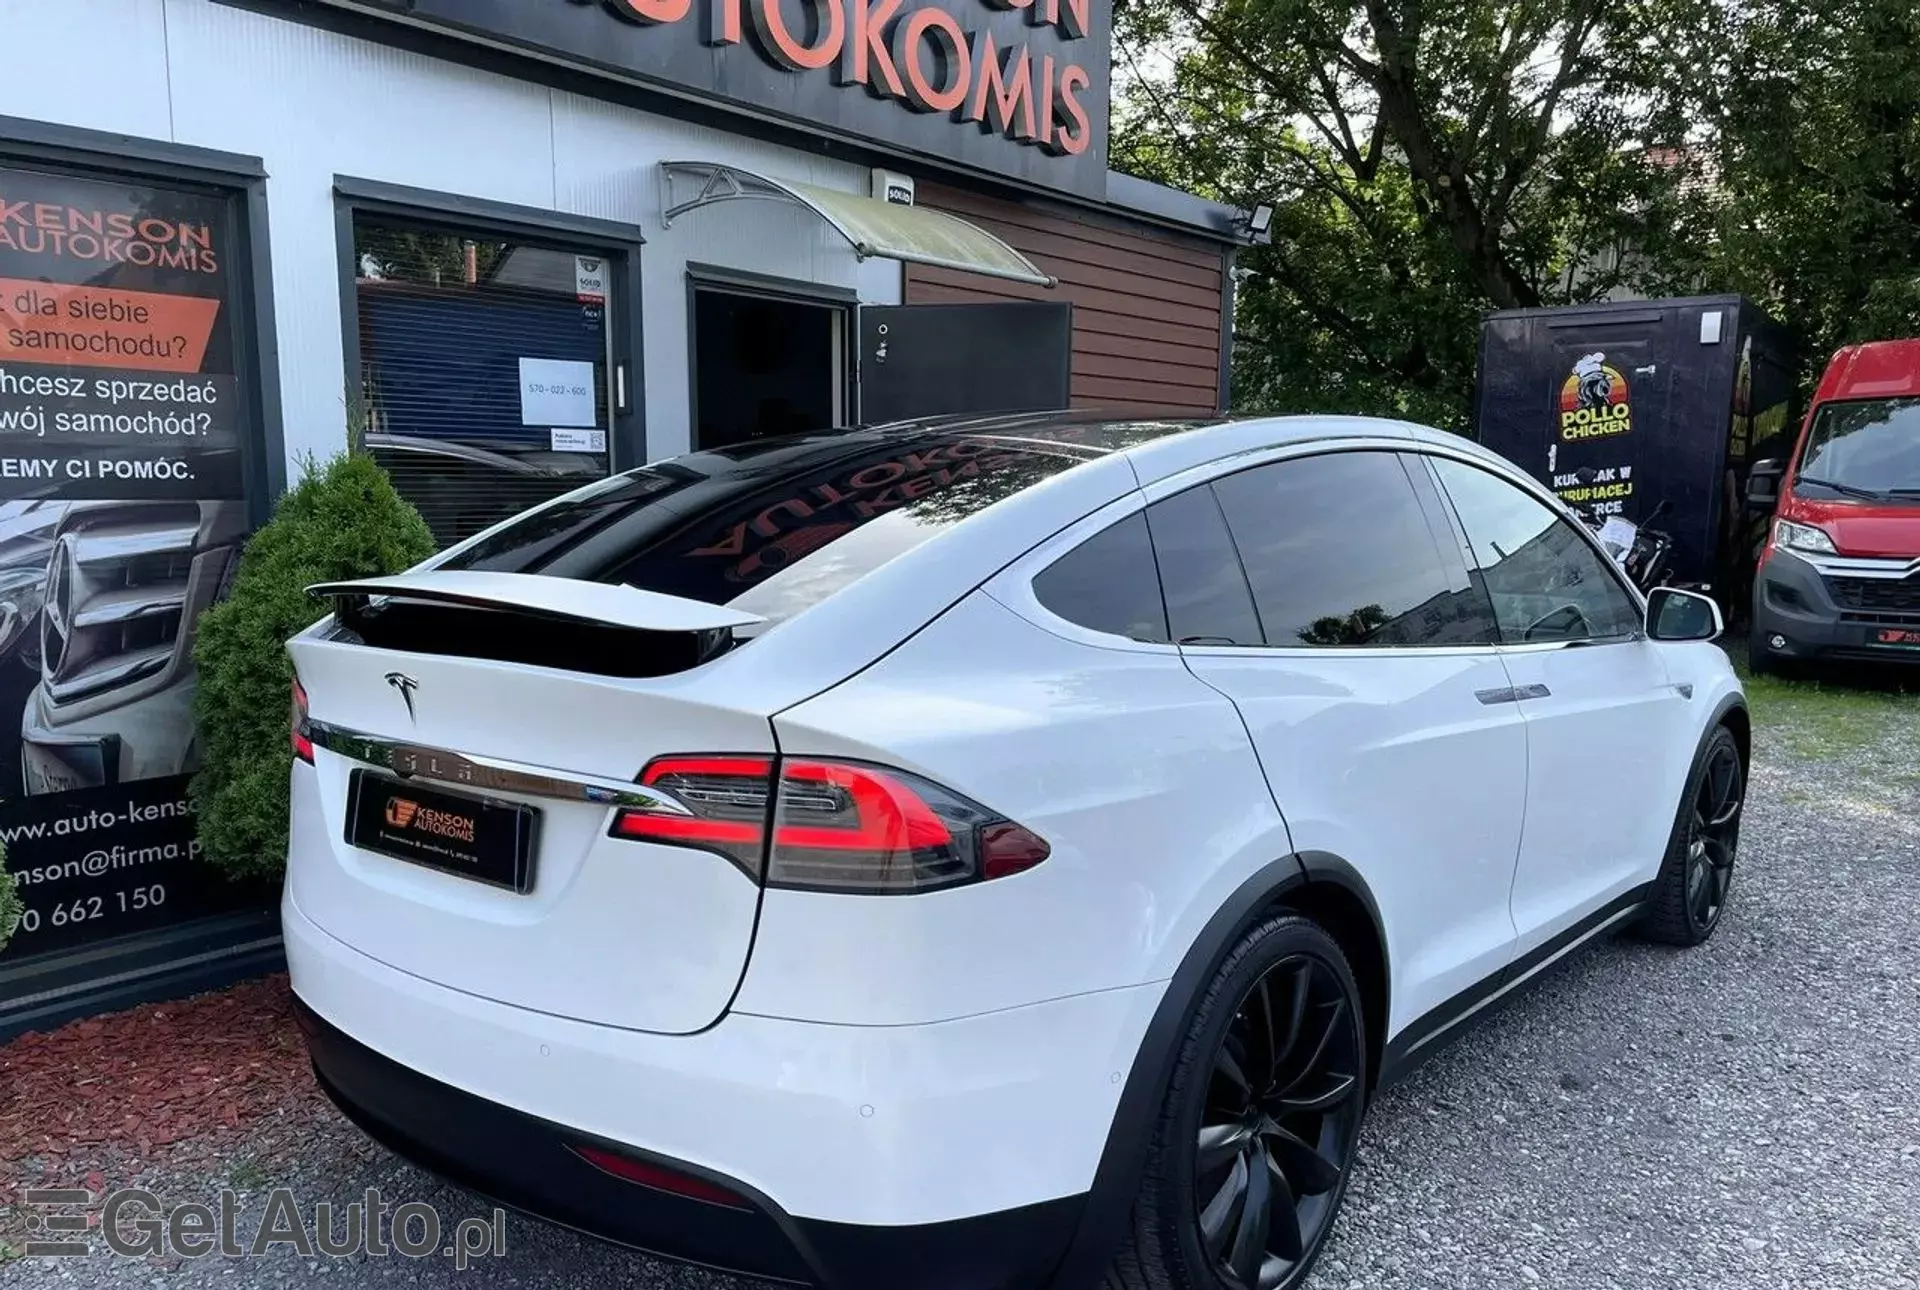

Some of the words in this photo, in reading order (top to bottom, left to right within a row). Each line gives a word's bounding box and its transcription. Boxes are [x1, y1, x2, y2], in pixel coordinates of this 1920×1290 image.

[628, 0, 1090, 155] OKOMIS
[0, 199, 211, 248] KENSON
[14, 290, 58, 316] dla
[69, 296, 149, 324] siebie
[8, 328, 187, 358] samochodu?
[95, 379, 217, 405] sprzedać
[55, 411, 211, 436] samochód?
[1561, 403, 1630, 428] POLLO
[1562, 419, 1631, 440] CHICKEN
[0, 459, 58, 478] EMY
[65, 459, 90, 478] CI
[99, 457, 195, 480] POMÓC.
[1620, 466, 1632, 480] W
[414, 819, 475, 843] AUTOKOMIS
[417, 807, 474, 831] KENSON
[52, 897, 104, 926] 662
[116, 884, 165, 912] 150
